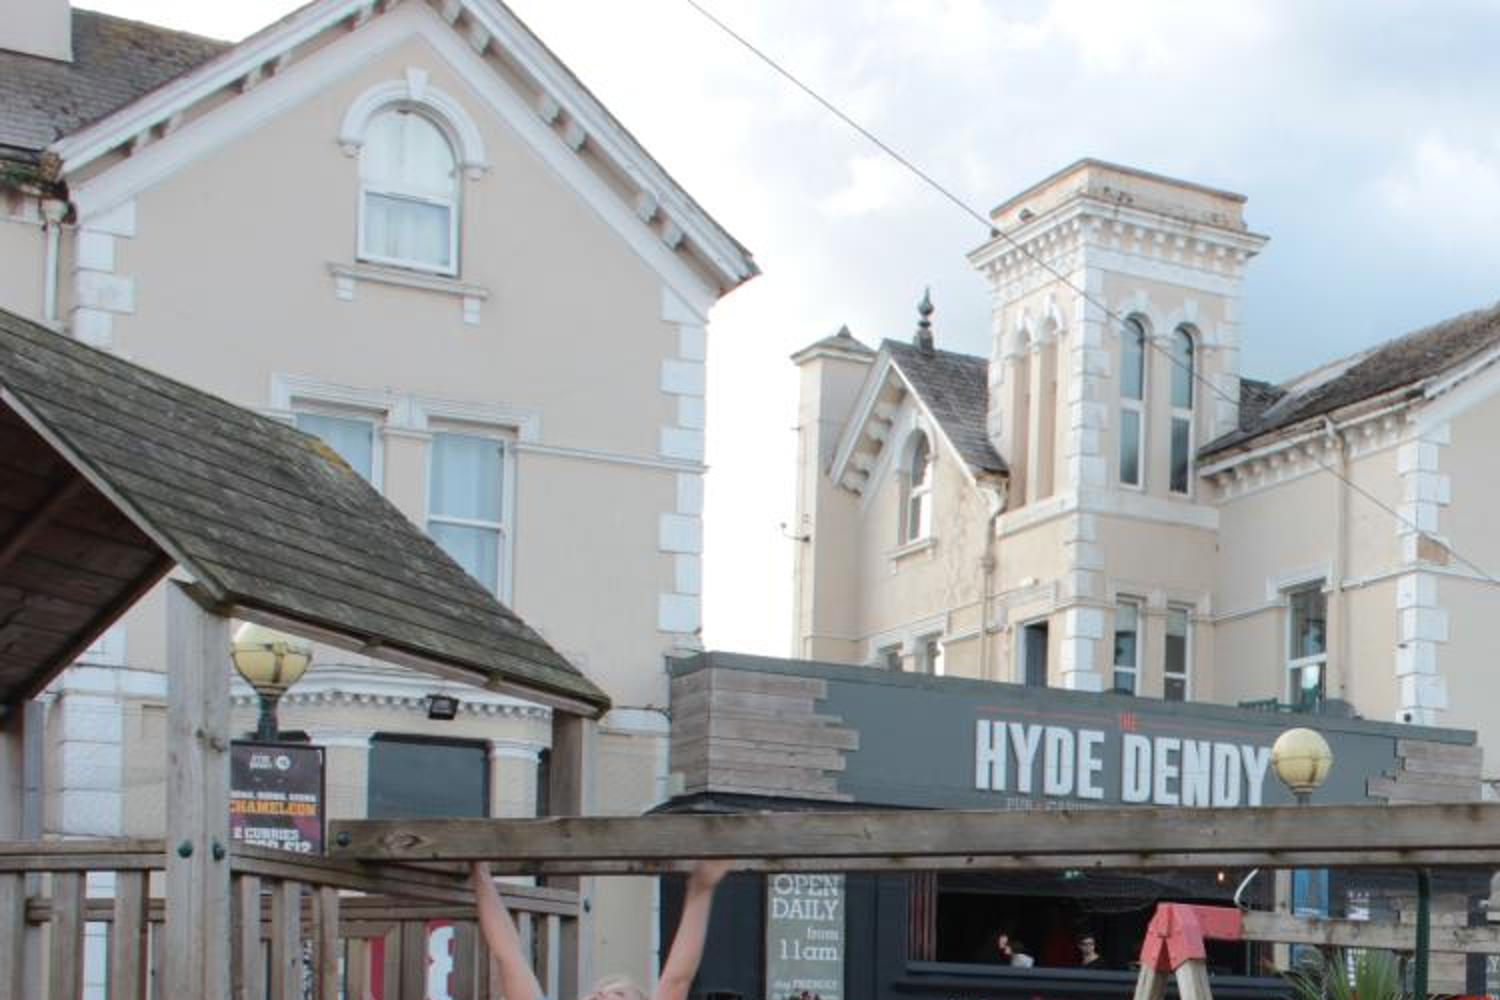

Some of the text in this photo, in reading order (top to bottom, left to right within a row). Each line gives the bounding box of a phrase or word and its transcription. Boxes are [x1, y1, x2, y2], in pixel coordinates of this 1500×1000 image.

[975, 719, 1272, 808] HYDE DENDY
[774, 874, 839, 896] OPEN
[772, 897, 839, 920] DAILY
[781, 940, 838, 961] 11am
